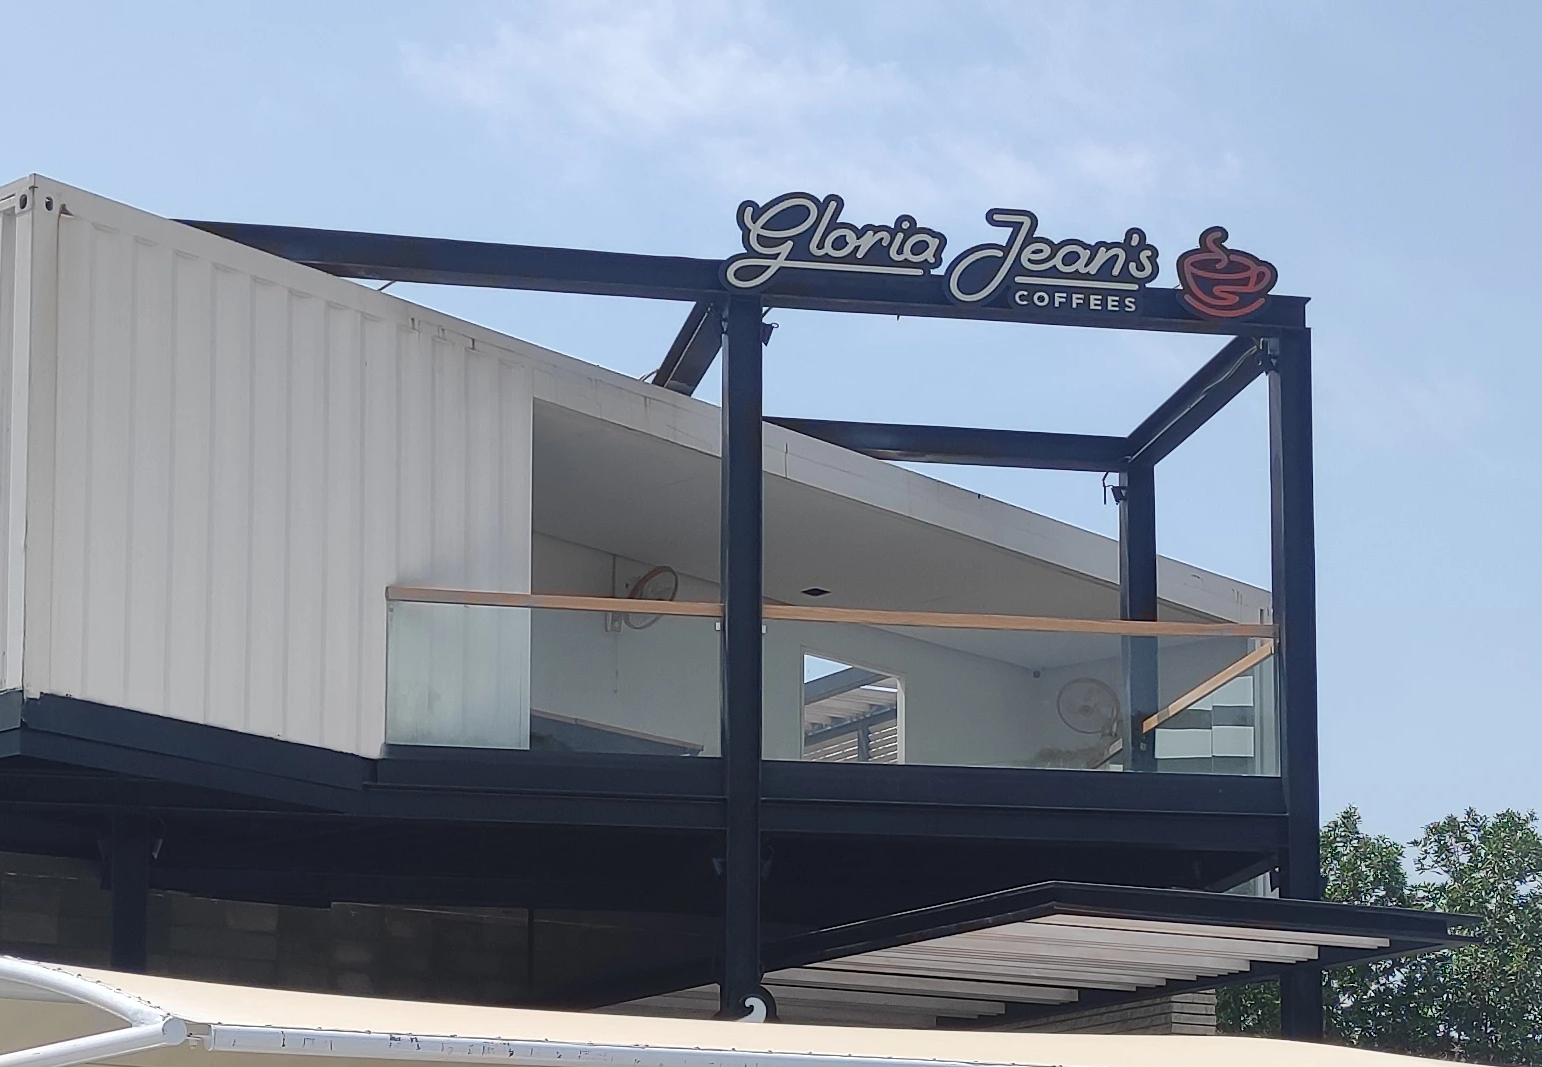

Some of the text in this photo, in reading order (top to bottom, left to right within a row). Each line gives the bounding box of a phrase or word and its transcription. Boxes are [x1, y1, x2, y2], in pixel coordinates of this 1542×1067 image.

[724, 196, 1156, 303] Gloria Jean's
[1014, 289, 1139, 313] COFFEES
